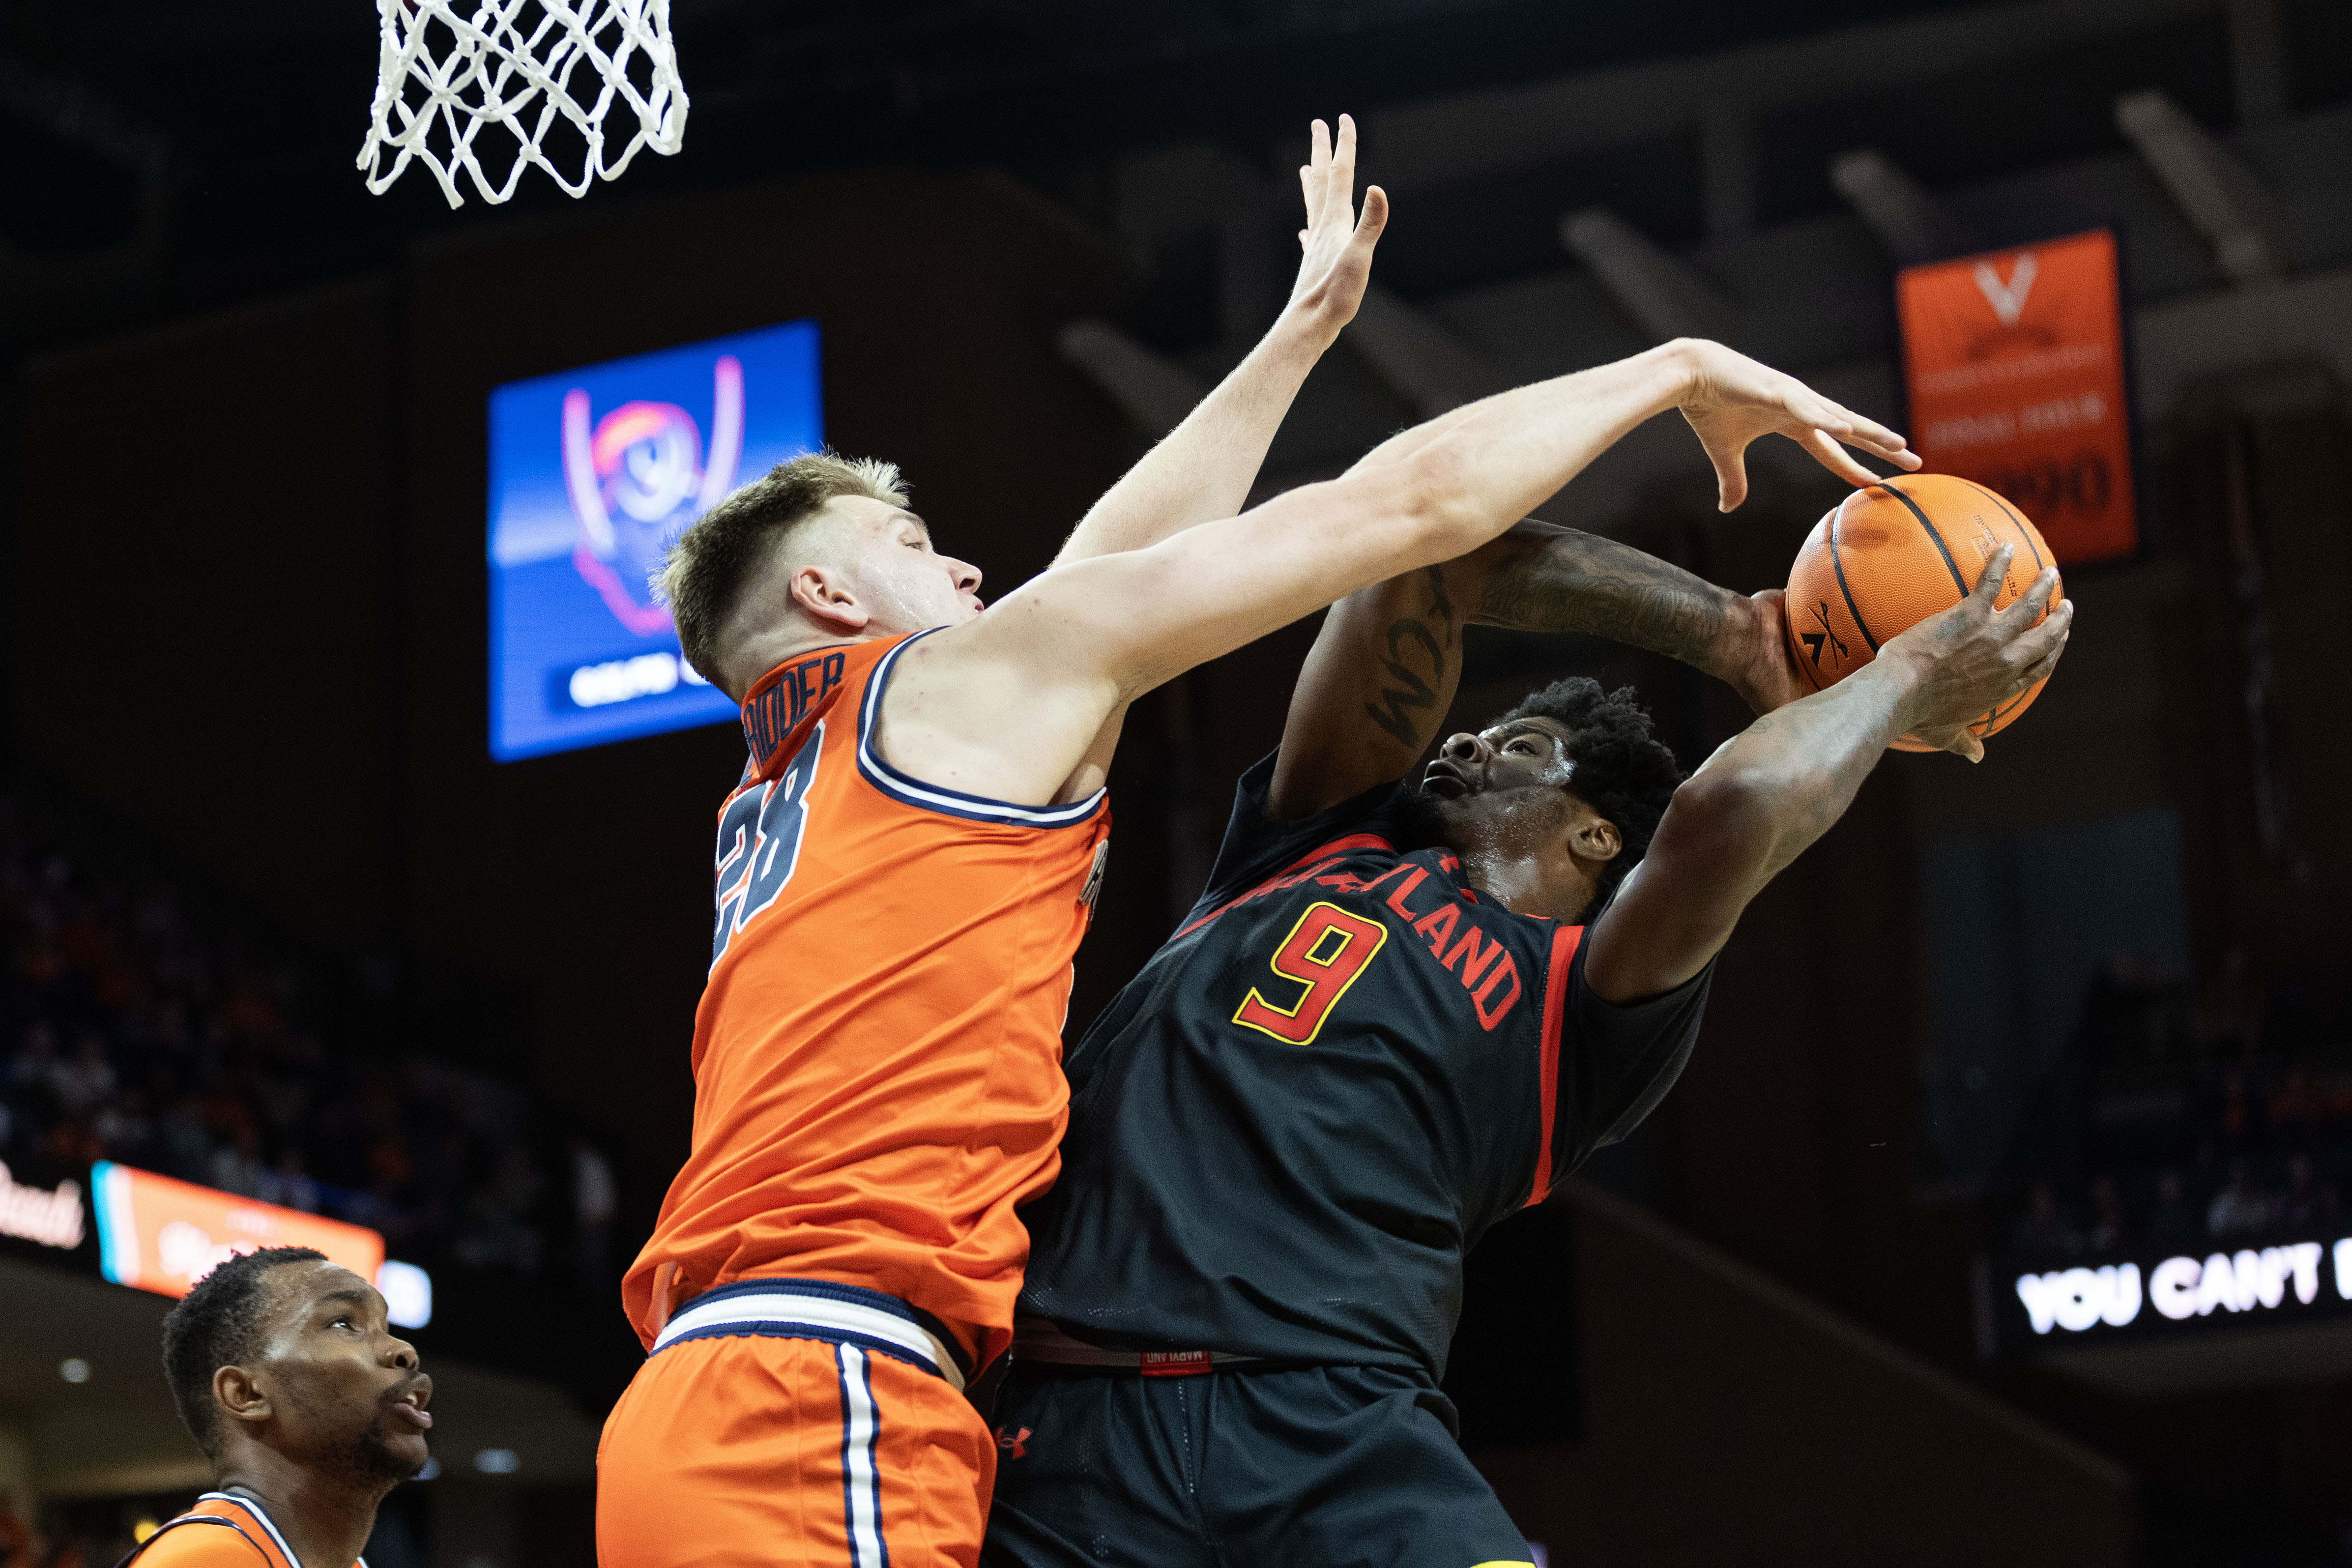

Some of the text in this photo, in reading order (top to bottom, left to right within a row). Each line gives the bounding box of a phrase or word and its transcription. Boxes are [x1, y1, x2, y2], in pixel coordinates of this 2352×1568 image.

[708, 717, 826, 981] 28
[1231, 901, 1388, 1046] 9
[2015, 1262, 2143, 1335] YOU
[2149, 1242, 2323, 1321] CAN'T
